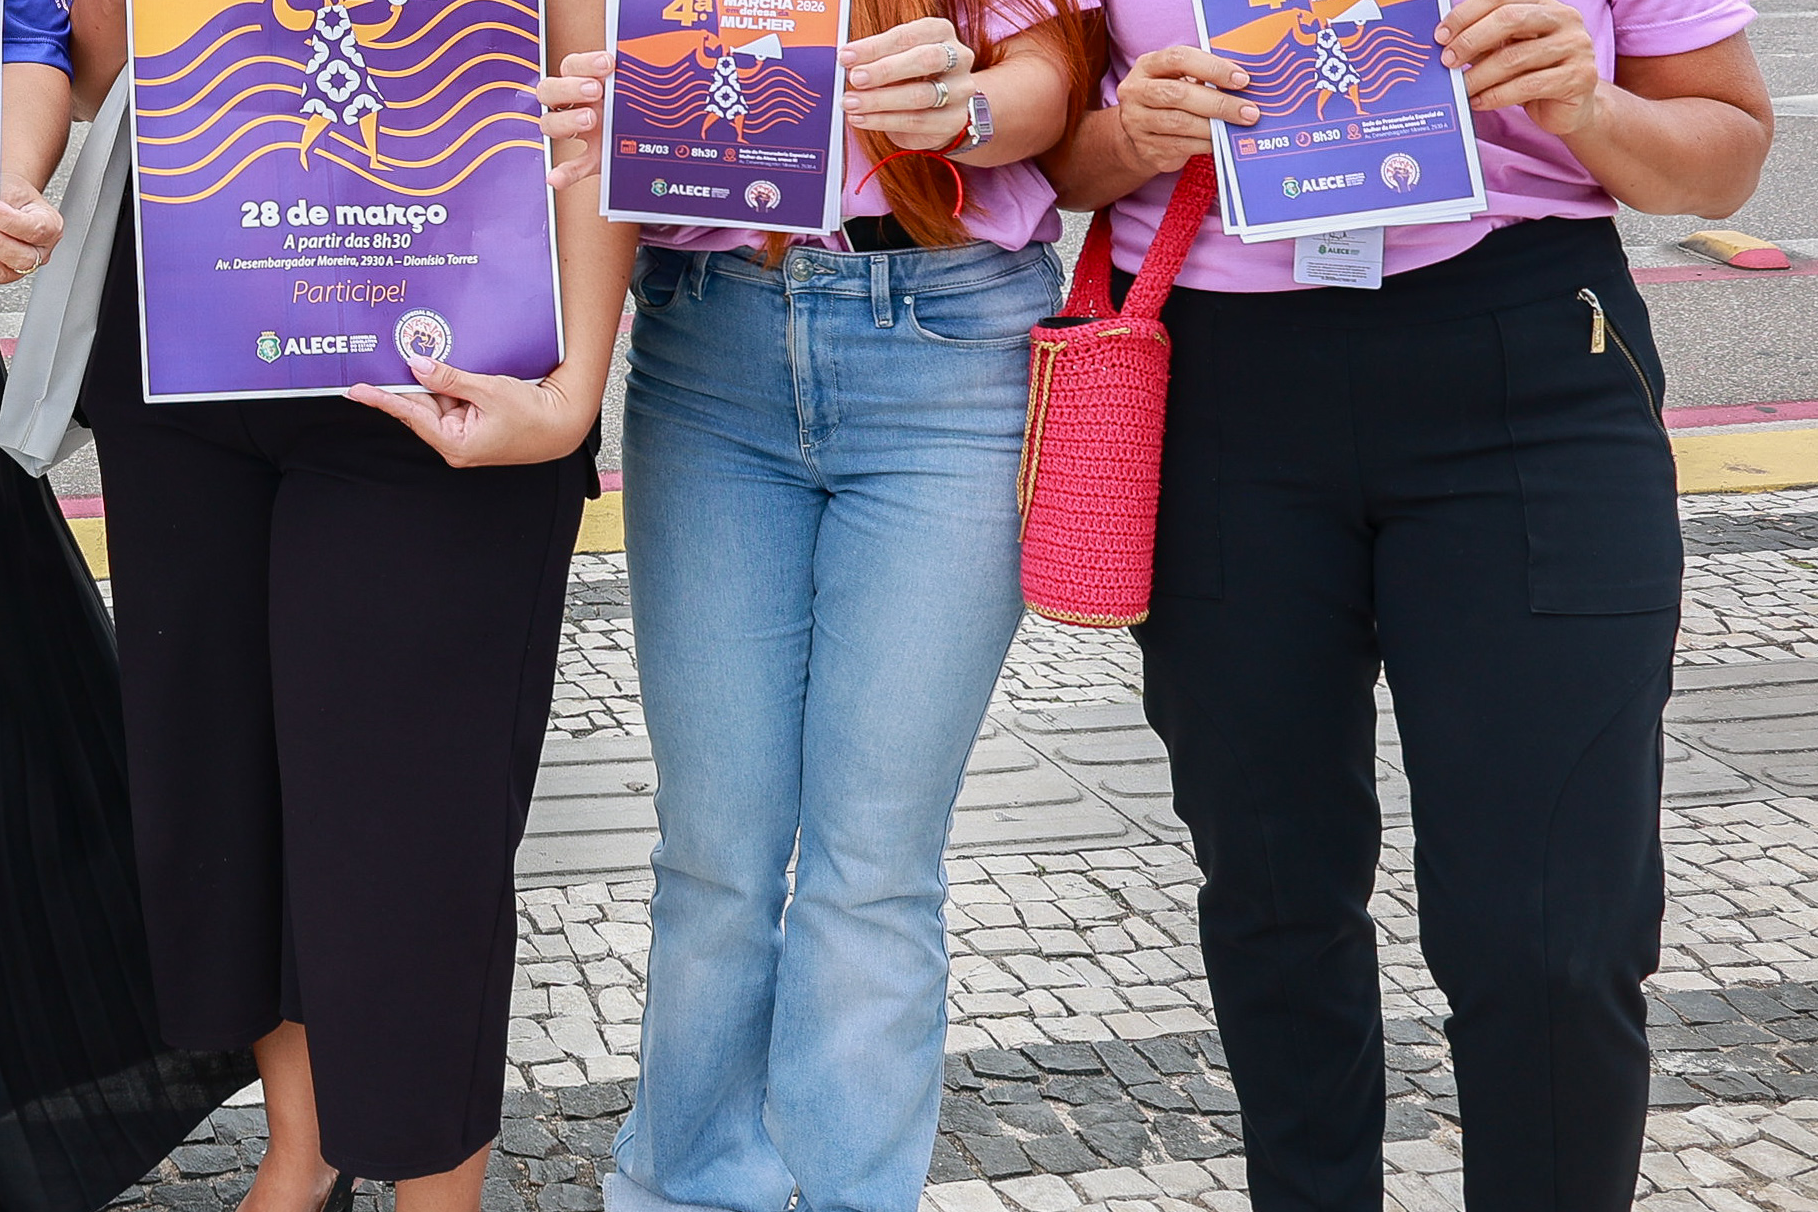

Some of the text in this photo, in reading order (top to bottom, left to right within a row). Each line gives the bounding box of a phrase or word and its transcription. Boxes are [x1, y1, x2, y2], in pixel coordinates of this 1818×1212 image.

[796, 0, 826, 13] 2026
[720, 16, 796, 32] MULHER
[1257, 136, 1290, 151] 28/03
[1312, 128, 1341, 143] 8h30
[638, 143, 669, 155] 28/03
[691, 147, 718, 159] 8h30
[668, 184, 711, 198] ALECE
[1301, 175, 1346, 193] ALECE
[240, 198, 449, 234] 28 de março
[283, 232, 412, 253] A partir das 8h30
[215, 258, 232, 271] Av.
[232, 255, 316, 271] Desembargador
[317, 255, 359, 268] Moreira,
[360, 255, 385, 267] 2930
[385, 255, 395, 267] A
[403, 254, 446, 266] Dionísio
[446, 253, 479, 266] Torres
[292, 279, 407, 308] Participe!
[284, 336, 349, 356] ALECE
